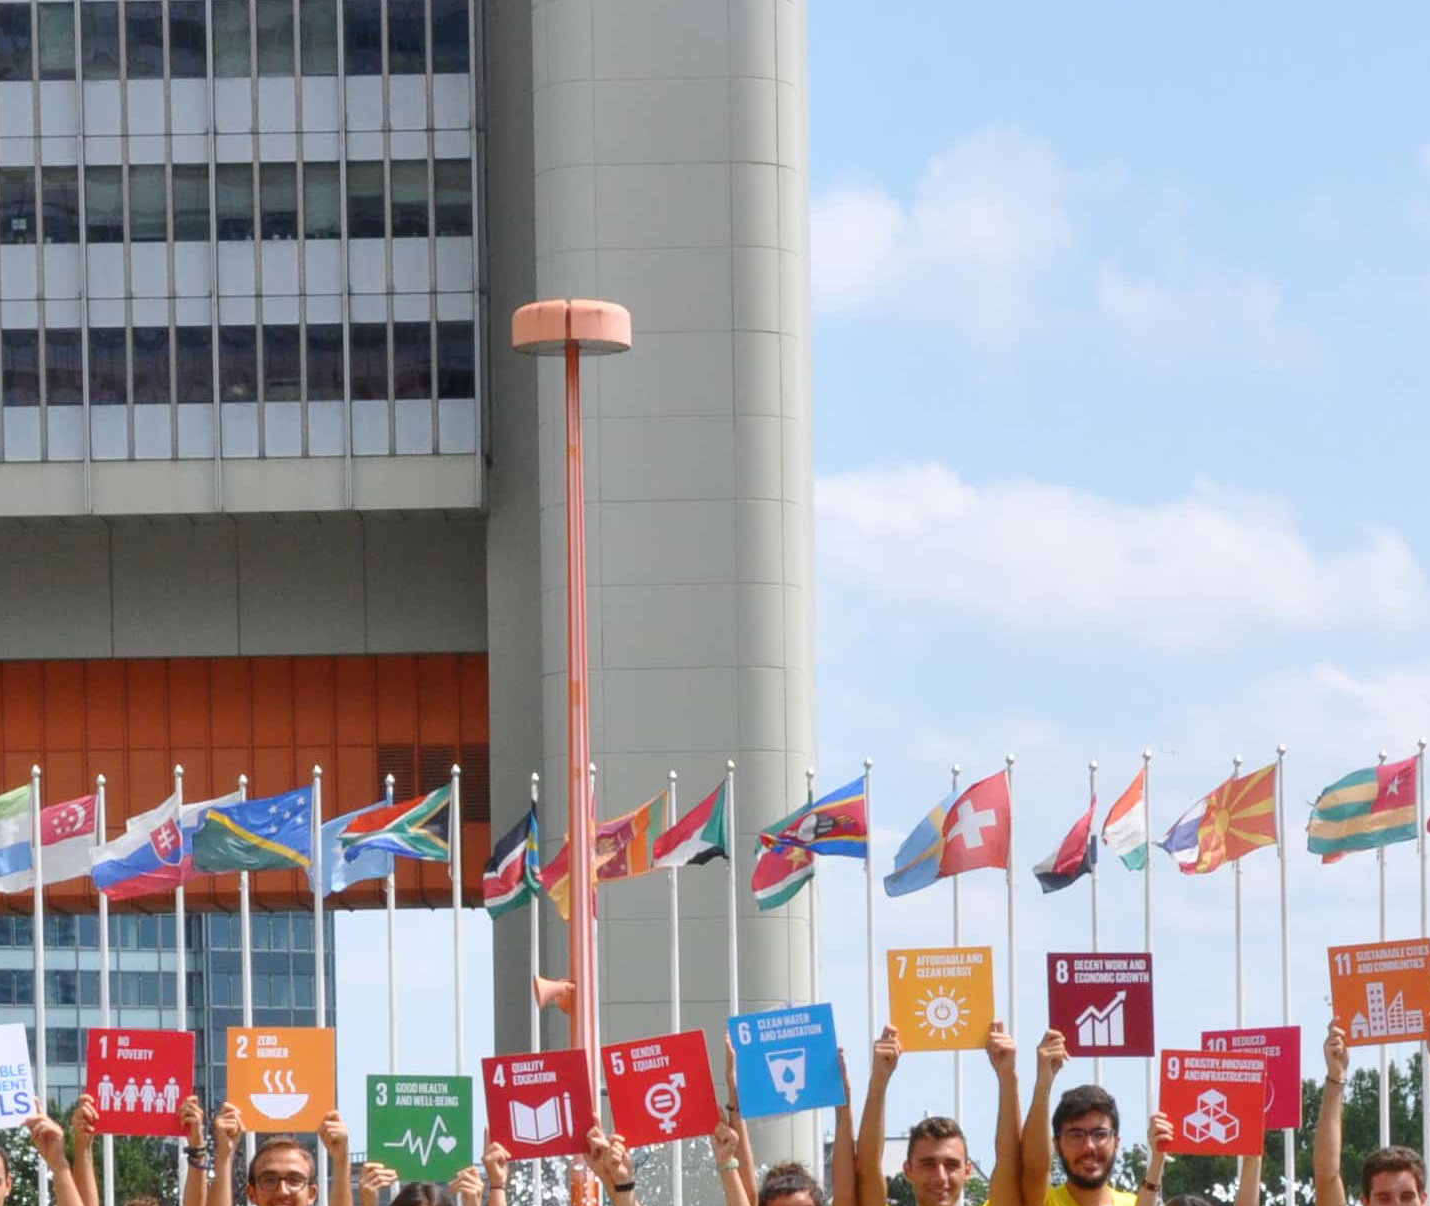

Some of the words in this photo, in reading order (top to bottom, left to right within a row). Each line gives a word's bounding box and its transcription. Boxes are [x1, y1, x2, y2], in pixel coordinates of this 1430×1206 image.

[896, 956, 907, 980] 7
[1056, 960, 1069, 984] 8
[1074, 960, 1102, 971] DECENT
[1104, 960, 1128, 971] WORK
[1129, 961, 1146, 971] AND
[1335, 952, 1351, 976] 11
[916, 967, 939, 978] CLEAN
[1116, 973, 1150, 983] GROWTH
[757, 1018, 782, 1030] CLEAN
[782, 1013, 810, 1027] WATER
[257, 1035, 278, 1047] ZERO
[738, 1022, 752, 1045] 6
[760, 1031, 777, 1042] AND
[99, 1036, 108, 1060] 1
[236, 1036, 249, 1059] 2
[630, 1045, 662, 1060] GENDER
[1207, 1037, 1227, 1052] 10
[117, 1048, 154, 1060] POVERTY
[512, 1060, 544, 1074] QUALITY
[611, 1051, 625, 1076] 5
[633, 1056, 669, 1072] EQUALITY
[1167, 1057, 1180, 1080] 9
[492, 1064, 506, 1088] 4
[376, 1082, 388, 1106] 3
[395, 1083, 418, 1094] GOOD
[419, 1083, 448, 1095] HEALTH
[395, 1095, 412, 1106] AND
[413, 1095, 459, 1107] WELL-BEING
